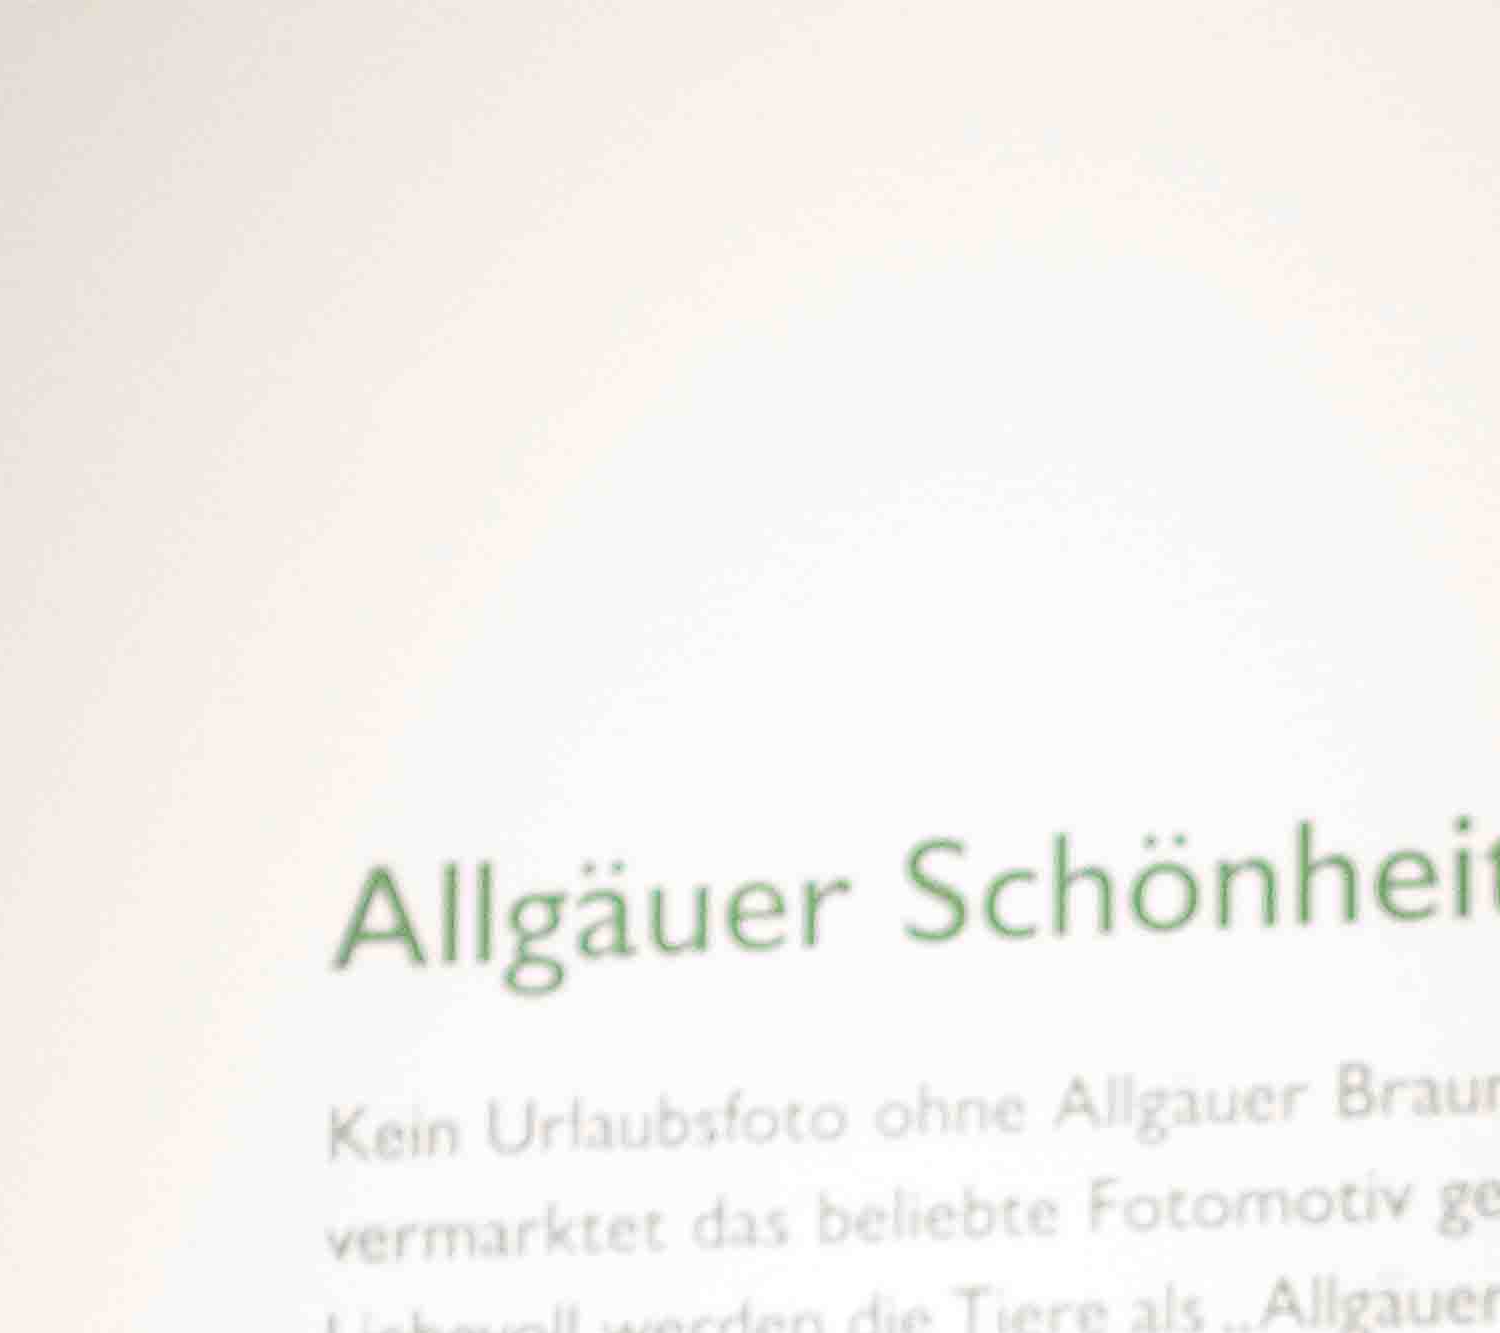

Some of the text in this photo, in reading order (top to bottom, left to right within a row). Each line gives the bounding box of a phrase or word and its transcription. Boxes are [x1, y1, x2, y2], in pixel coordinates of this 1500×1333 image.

[329, 858, 853, 999] Allgäuer
[324, 1103, 461, 1163] Kein
[483, 1088, 849, 1155] Urlaubsfoto
[872, 1081, 1027, 1141] ohne
[1052, 1072, 1310, 1148] Allgäuer
[322, 1200, 665, 1267] vermarktet
[690, 1193, 791, 1252] das
[815, 1184, 1061, 1247] beliebte
[1086, 1170, 1415, 1234] Fotomotiv
